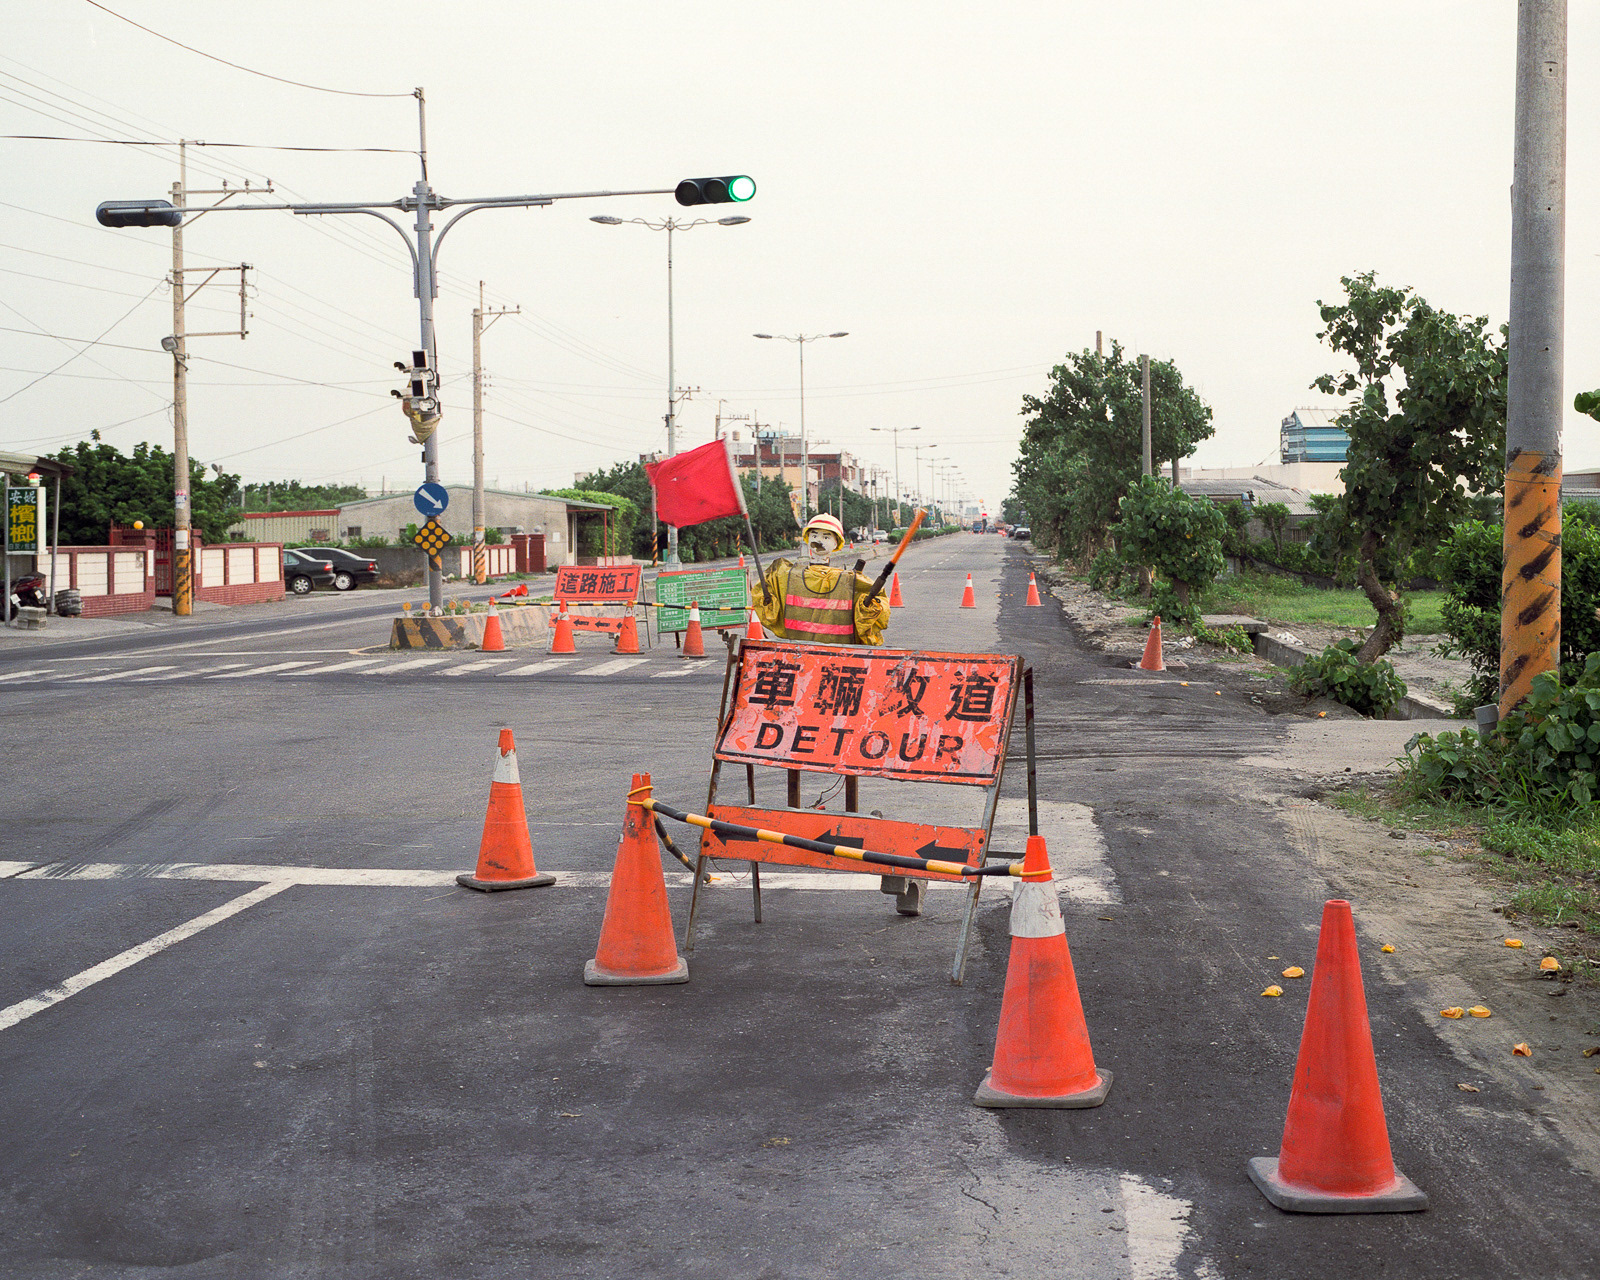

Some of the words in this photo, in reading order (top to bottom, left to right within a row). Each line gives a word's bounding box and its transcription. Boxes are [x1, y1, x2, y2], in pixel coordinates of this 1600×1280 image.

[10, 490, 37, 504] 安妮
[10, 504, 36, 543] 檳榔
[560, 572, 634, 594] 道路施工
[753, 722, 964, 764] DETOUR
